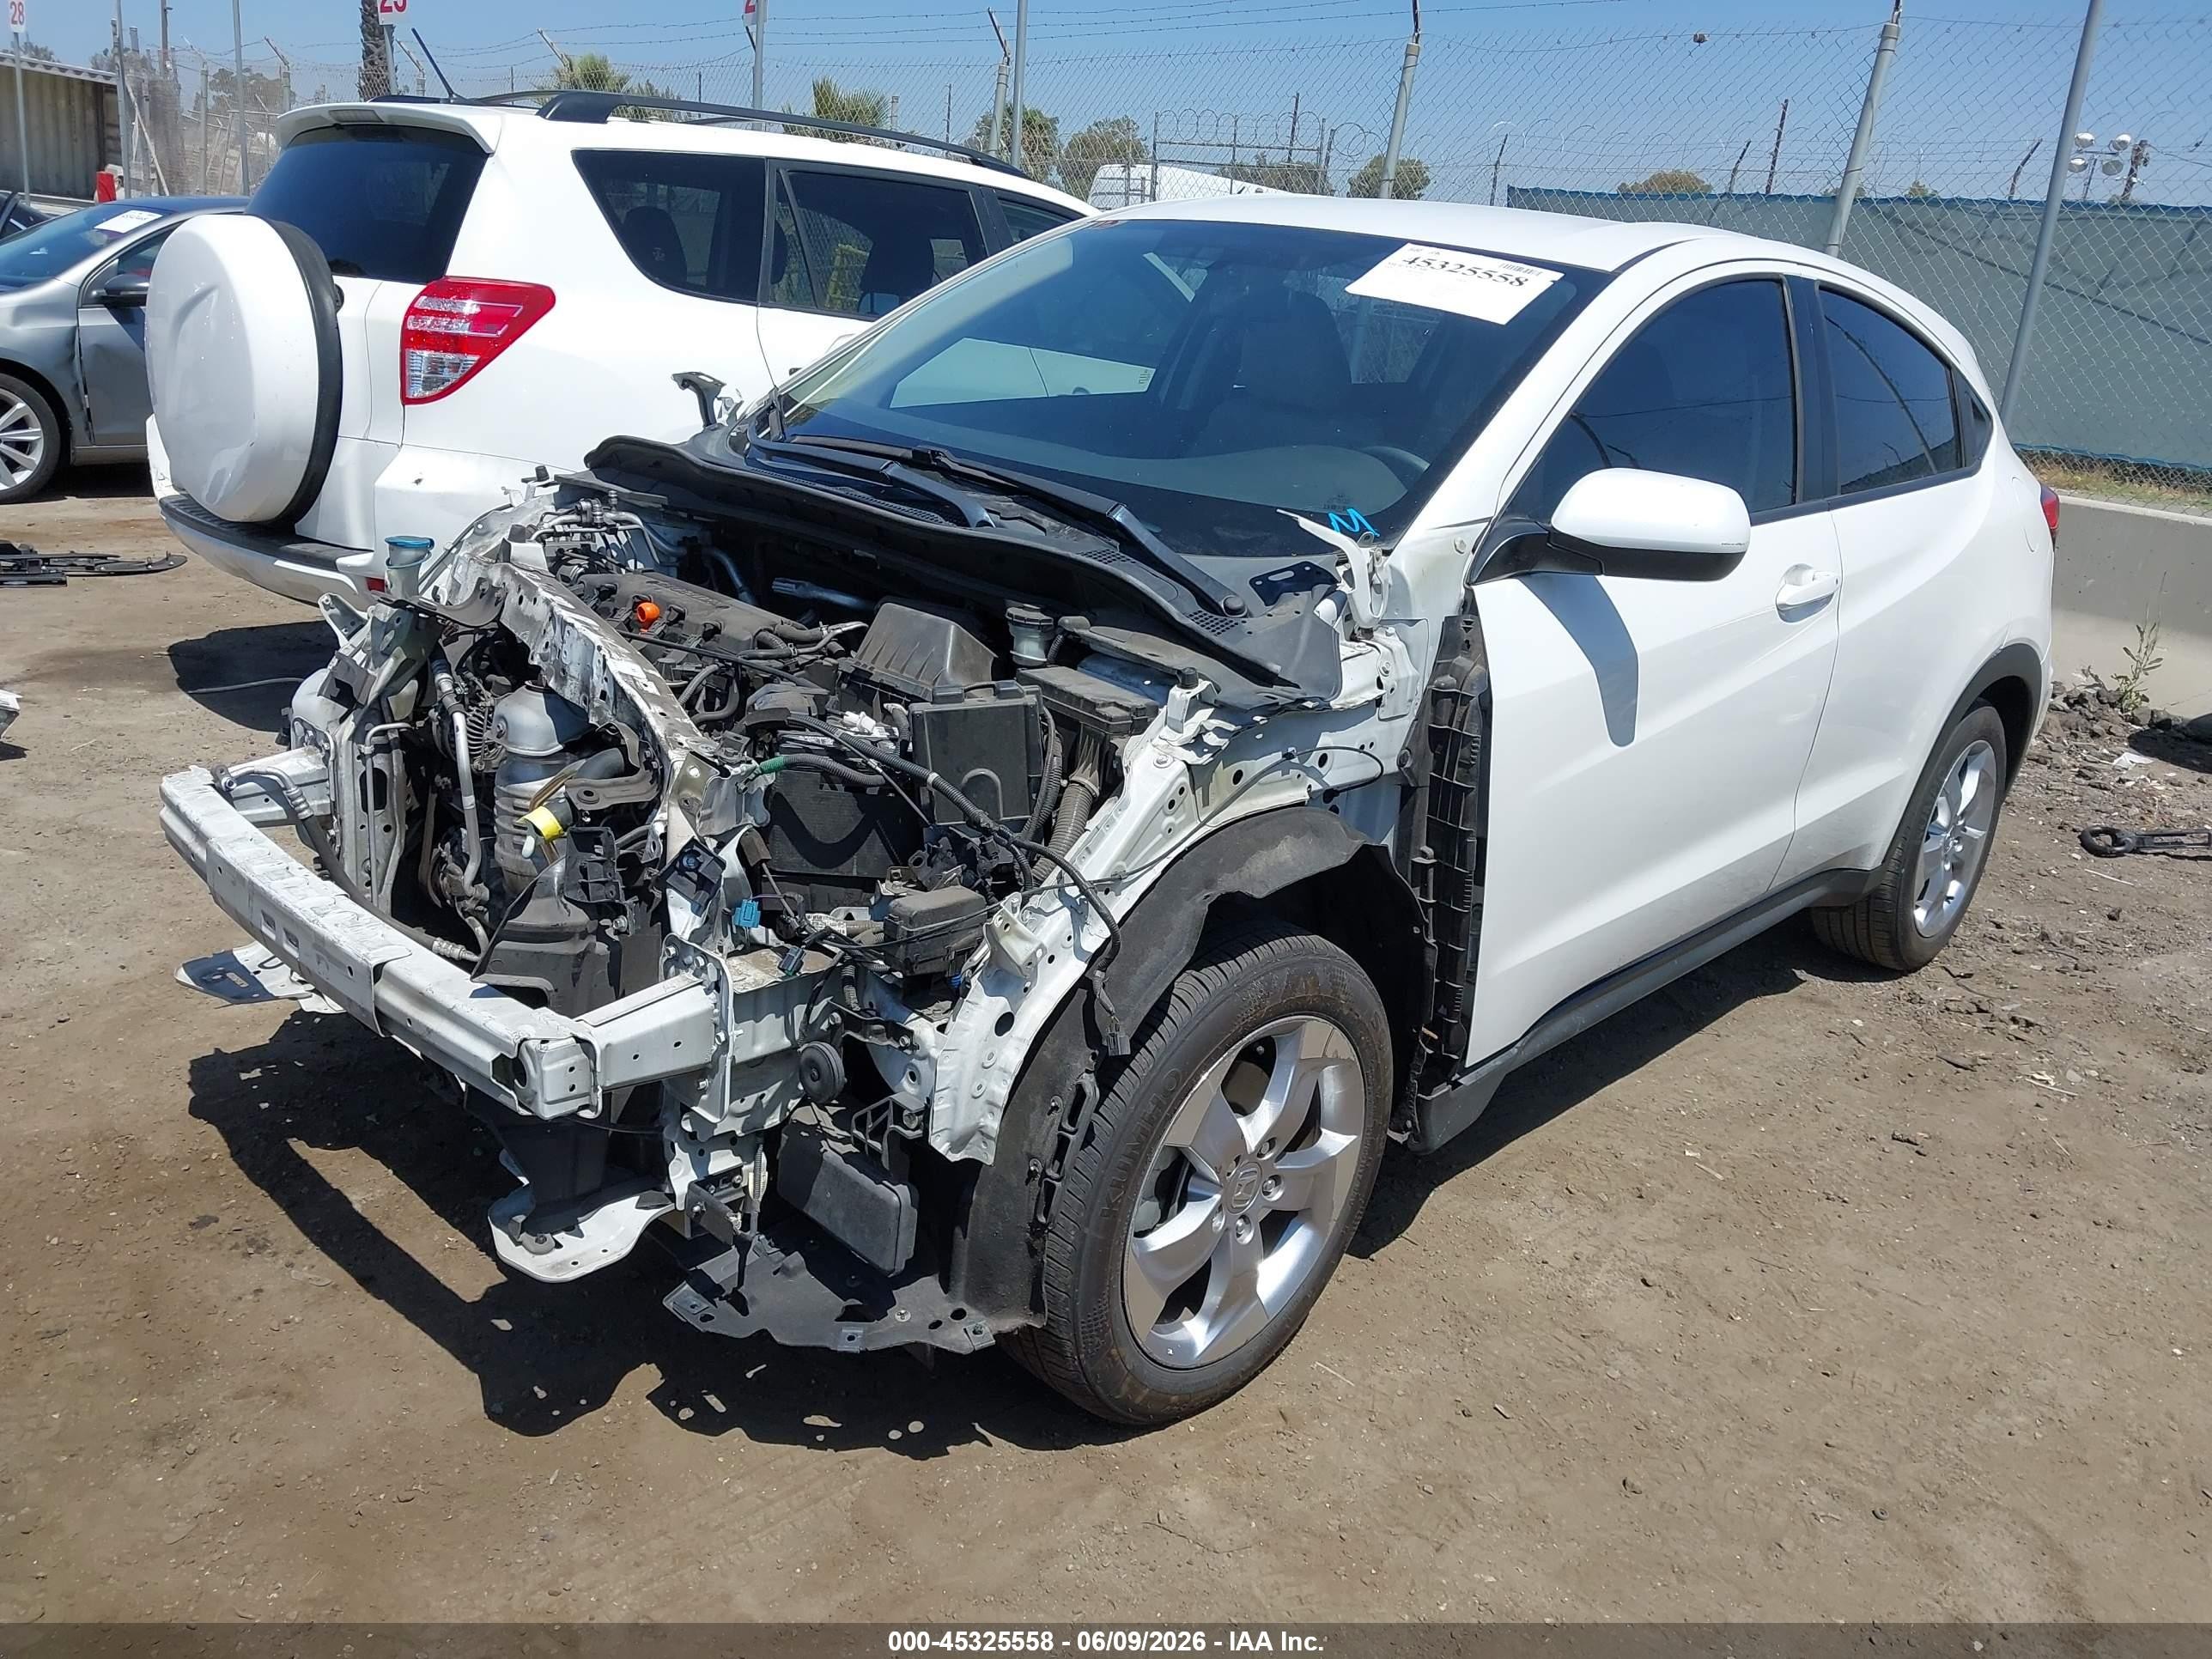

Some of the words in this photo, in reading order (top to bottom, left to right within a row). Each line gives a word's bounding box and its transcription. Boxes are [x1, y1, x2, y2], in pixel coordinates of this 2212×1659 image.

[9, 1, 25, 26] 28
[1402, 256, 1528, 287] 45325558
[1099, 1067, 1182, 1218] KUMHO
